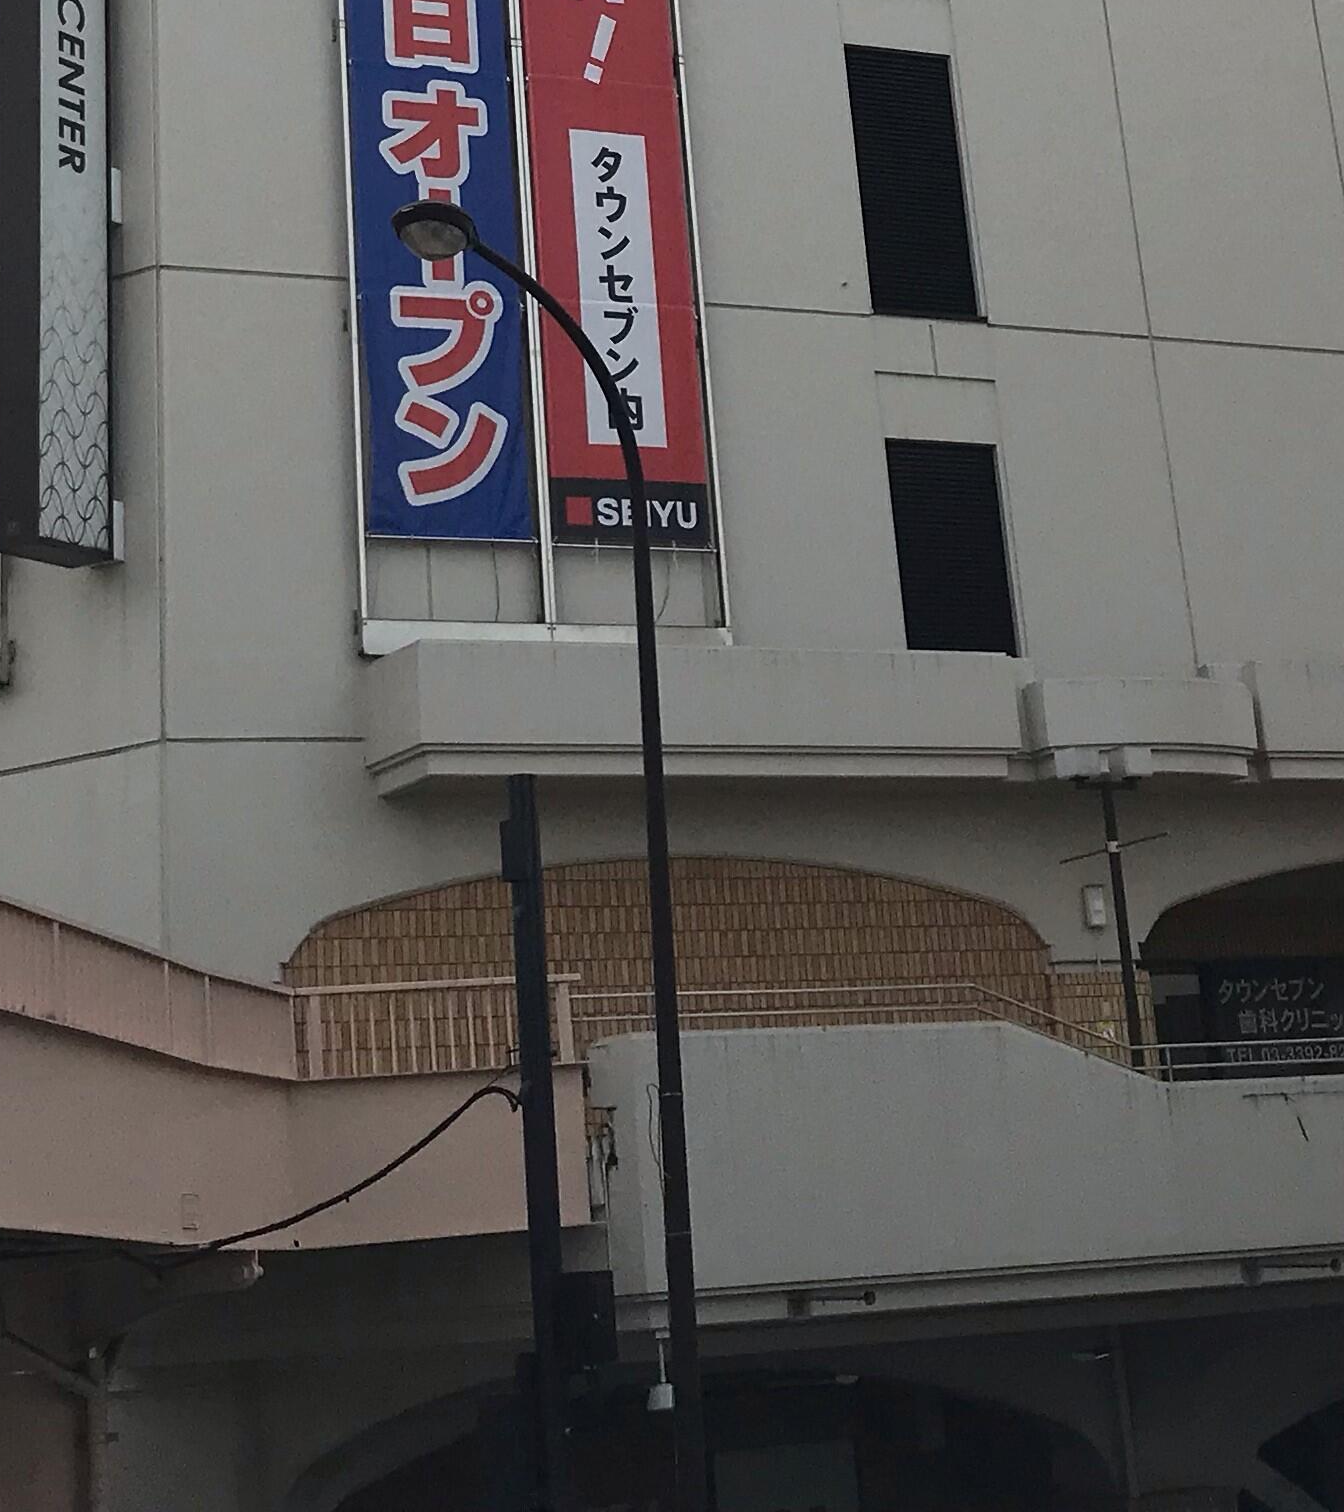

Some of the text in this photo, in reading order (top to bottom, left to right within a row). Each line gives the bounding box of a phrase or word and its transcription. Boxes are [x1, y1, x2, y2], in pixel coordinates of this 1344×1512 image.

[1218, 977, 1325, 1005] タウンセブン
